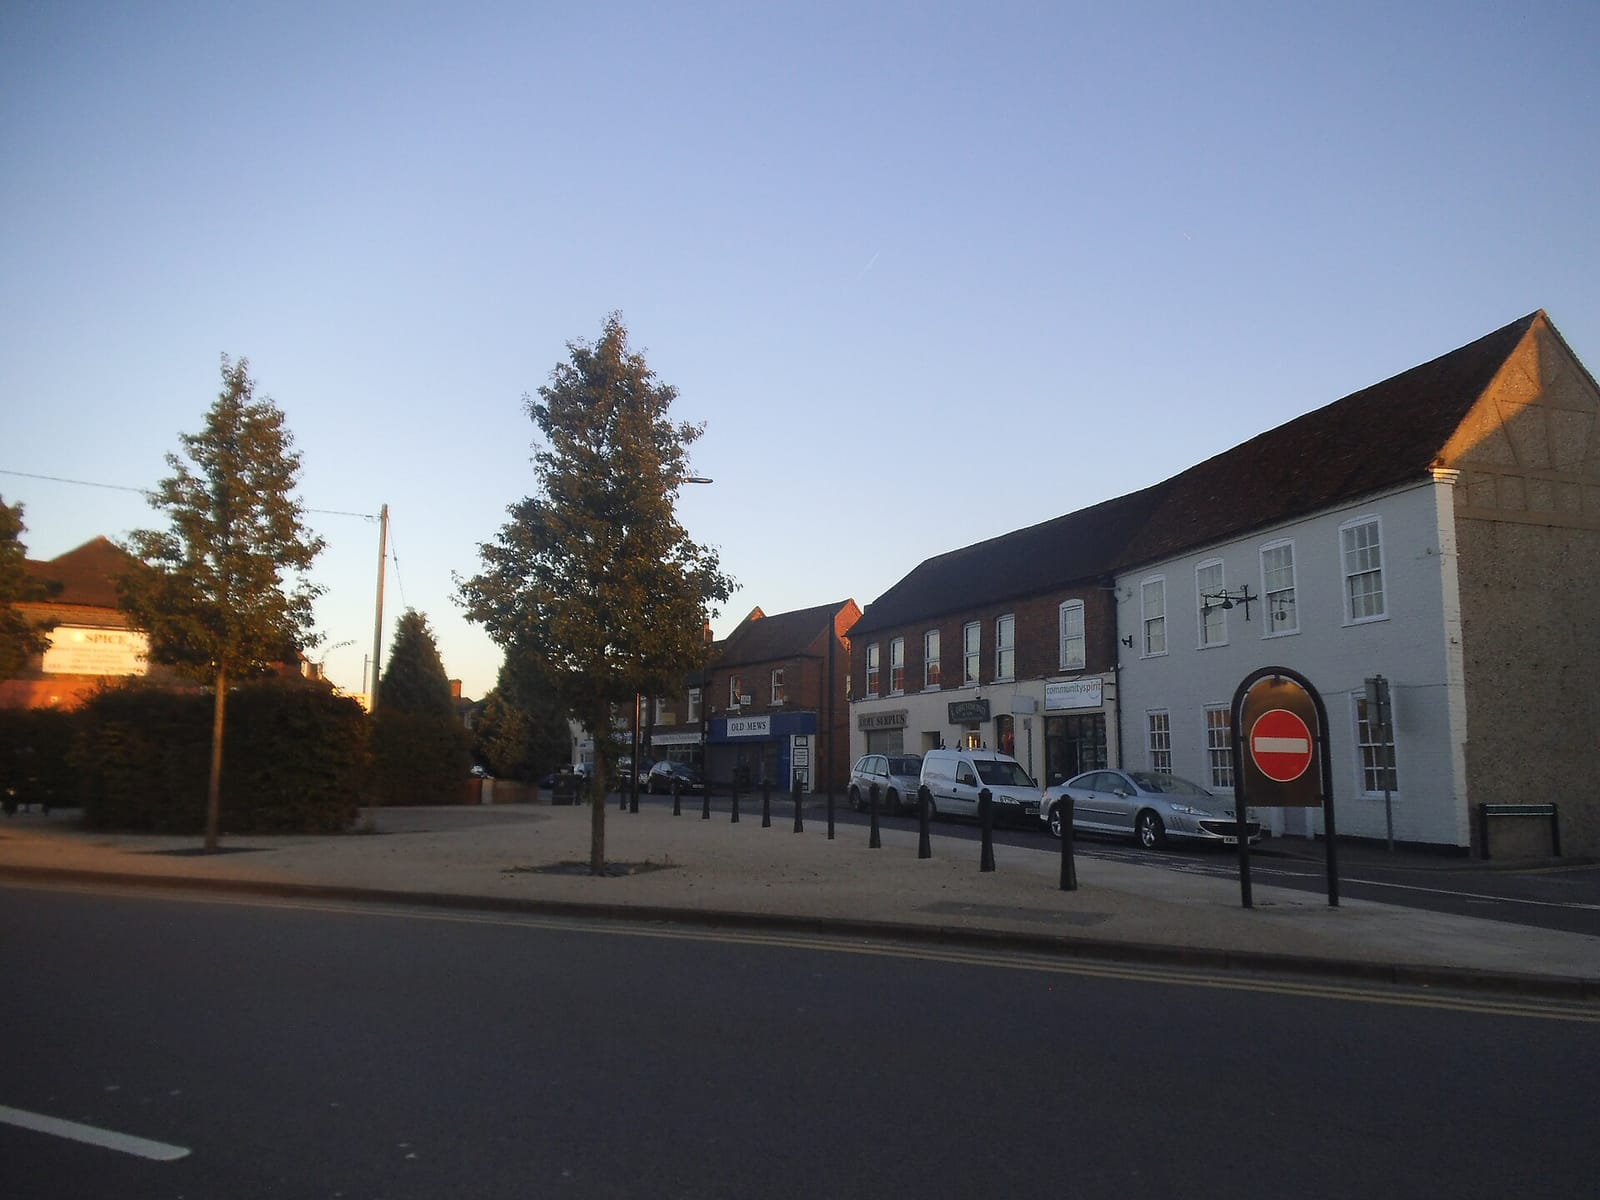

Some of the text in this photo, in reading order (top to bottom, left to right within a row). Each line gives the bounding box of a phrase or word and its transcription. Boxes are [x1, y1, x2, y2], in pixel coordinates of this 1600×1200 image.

[1046, 681, 1102, 695] communityspirit
[731, 721, 767, 732] OLD MEWS
